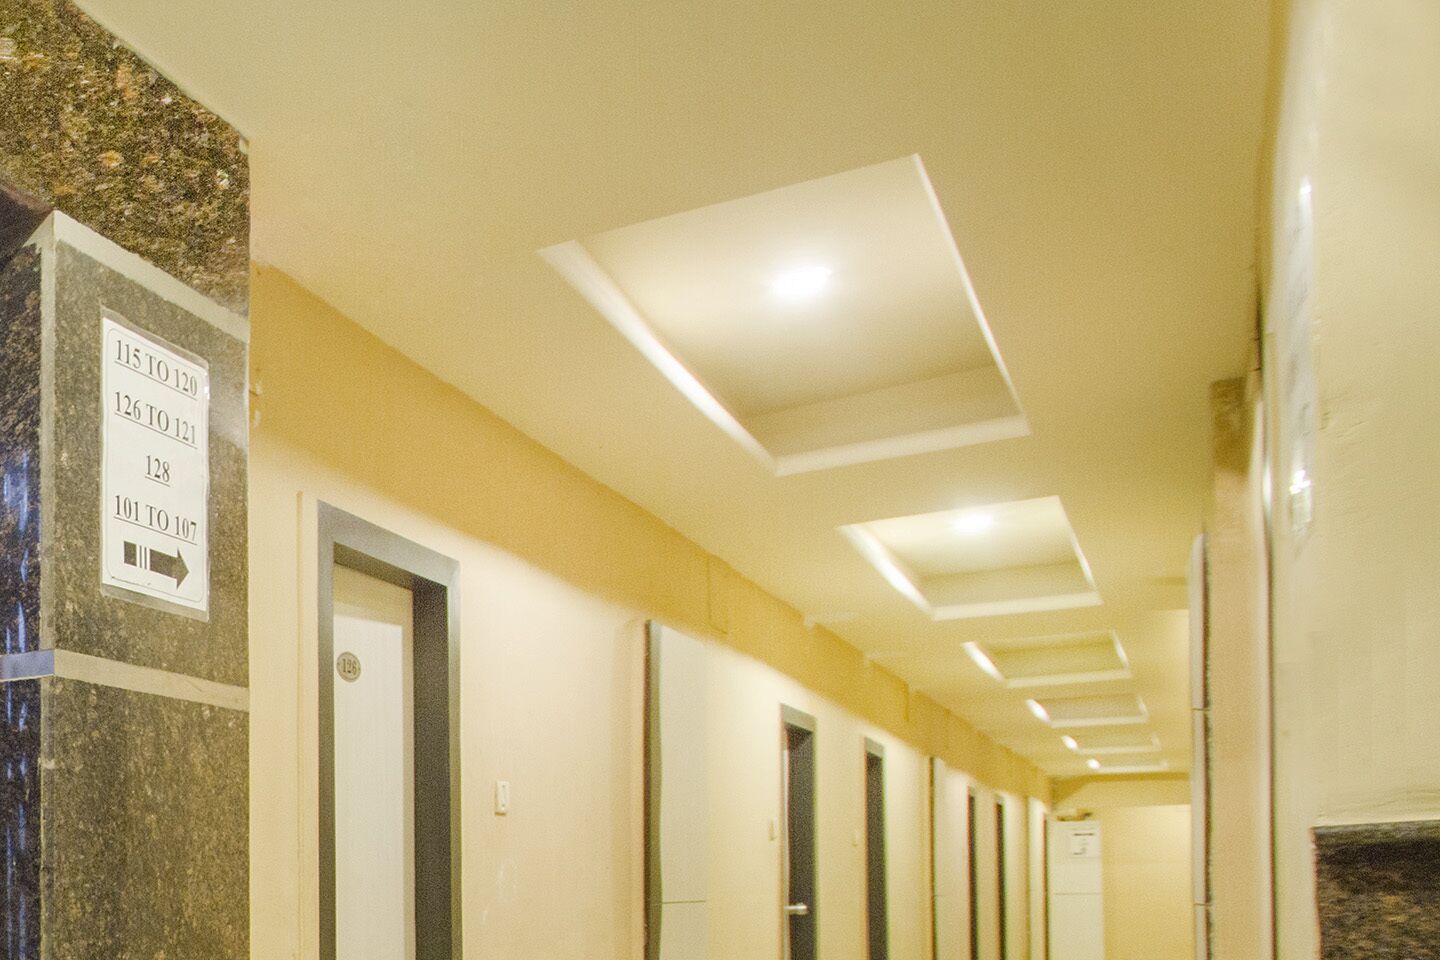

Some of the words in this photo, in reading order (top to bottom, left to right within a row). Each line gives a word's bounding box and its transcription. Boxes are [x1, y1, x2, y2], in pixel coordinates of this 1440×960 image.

[117, 340, 141, 369] 115
[145, 353, 169, 382] TO
[174, 369, 197, 396] 120
[115, 391, 141, 420] 126
[146, 403, 169, 432] TO
[175, 418, 196, 444] 121
[146, 455, 170, 483] 128
[115, 495, 140, 521] 101
[146, 504, 169, 532] TO
[175, 516, 197, 541] 107
